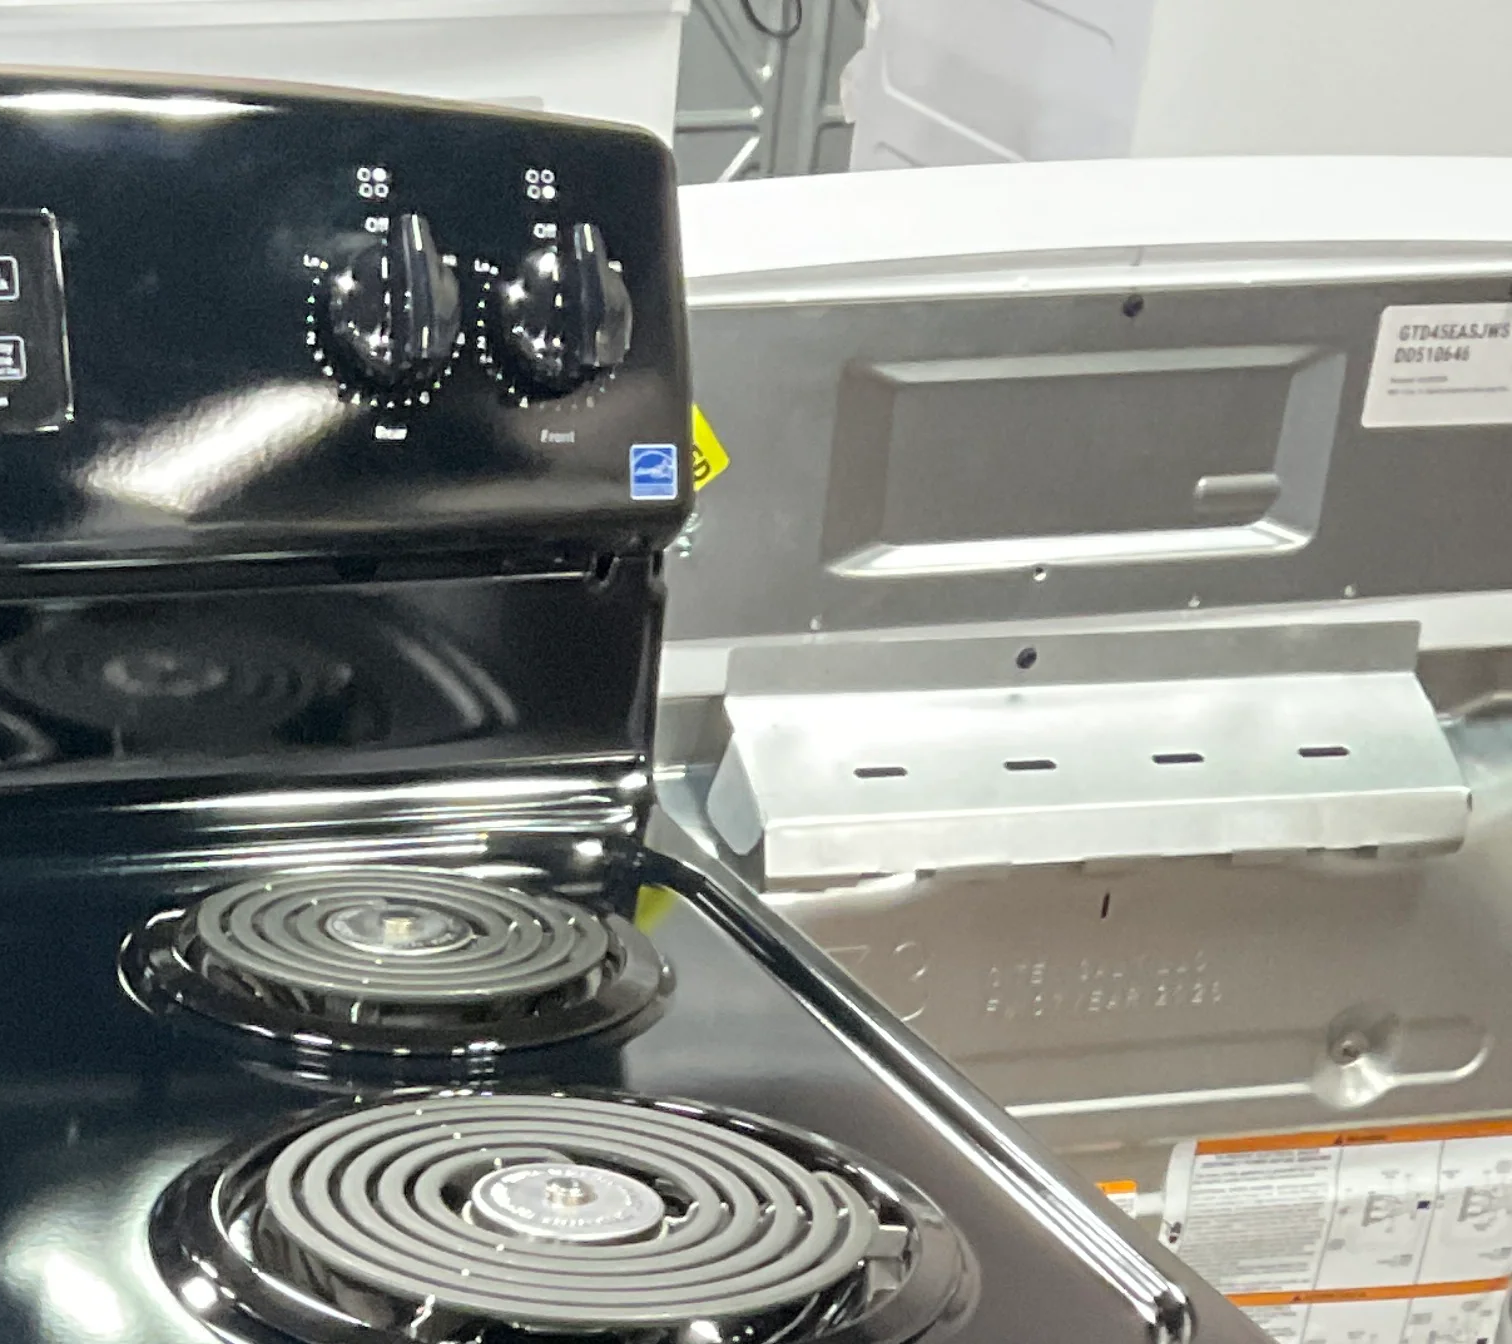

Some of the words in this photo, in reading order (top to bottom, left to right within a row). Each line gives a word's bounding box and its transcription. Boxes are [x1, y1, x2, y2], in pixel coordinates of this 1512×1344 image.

[365, 217, 388, 232] Off
[533, 224, 557, 238] Off
[306, 330, 316, 346] 2
